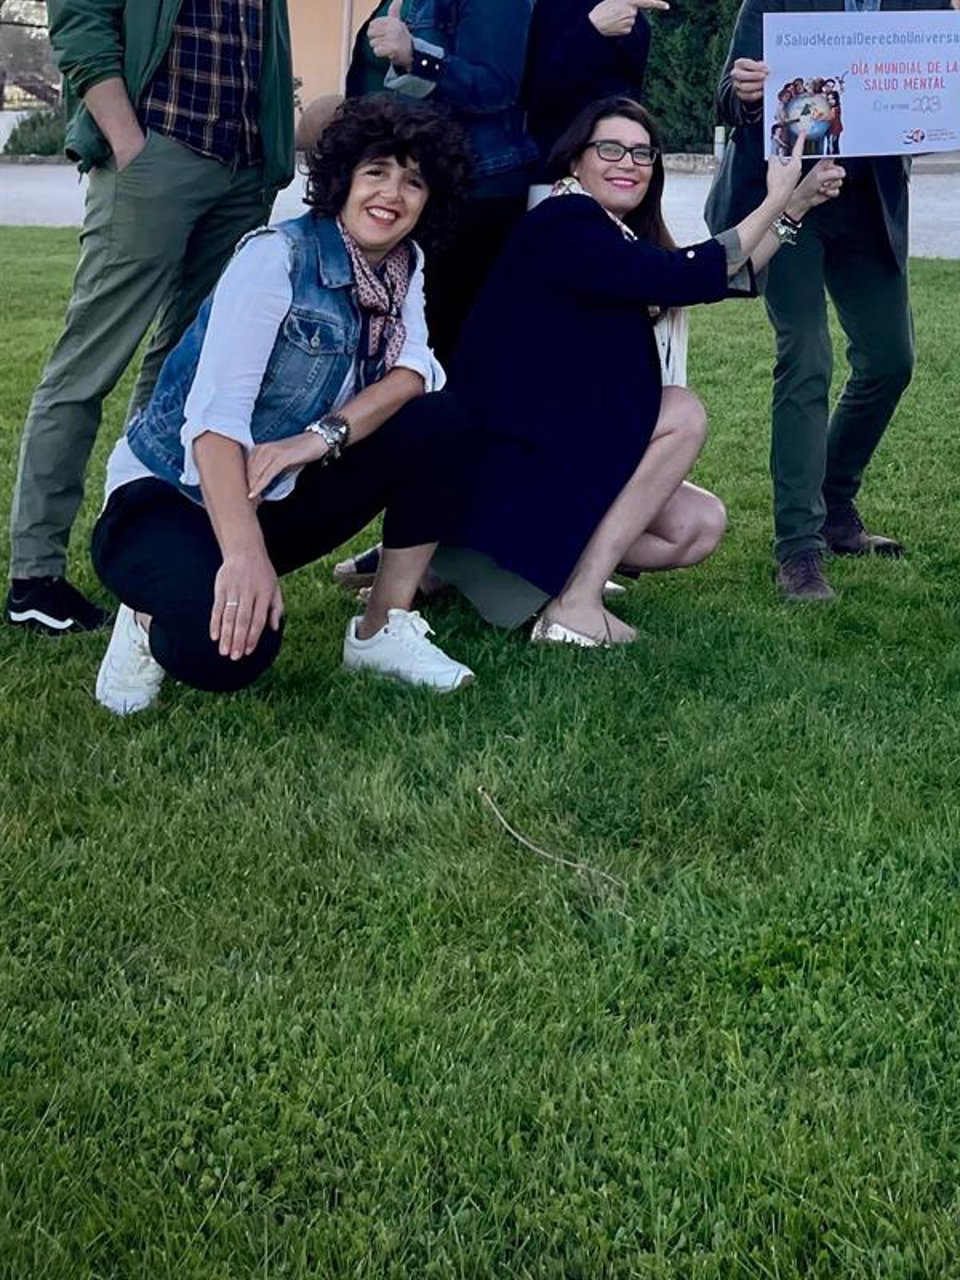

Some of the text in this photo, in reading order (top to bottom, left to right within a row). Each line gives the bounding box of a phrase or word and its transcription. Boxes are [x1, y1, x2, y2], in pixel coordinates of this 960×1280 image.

[851, 60, 959, 75] DÍA MUNDIAL DE LA
[864, 77, 946, 91] SALUD MENTAL
